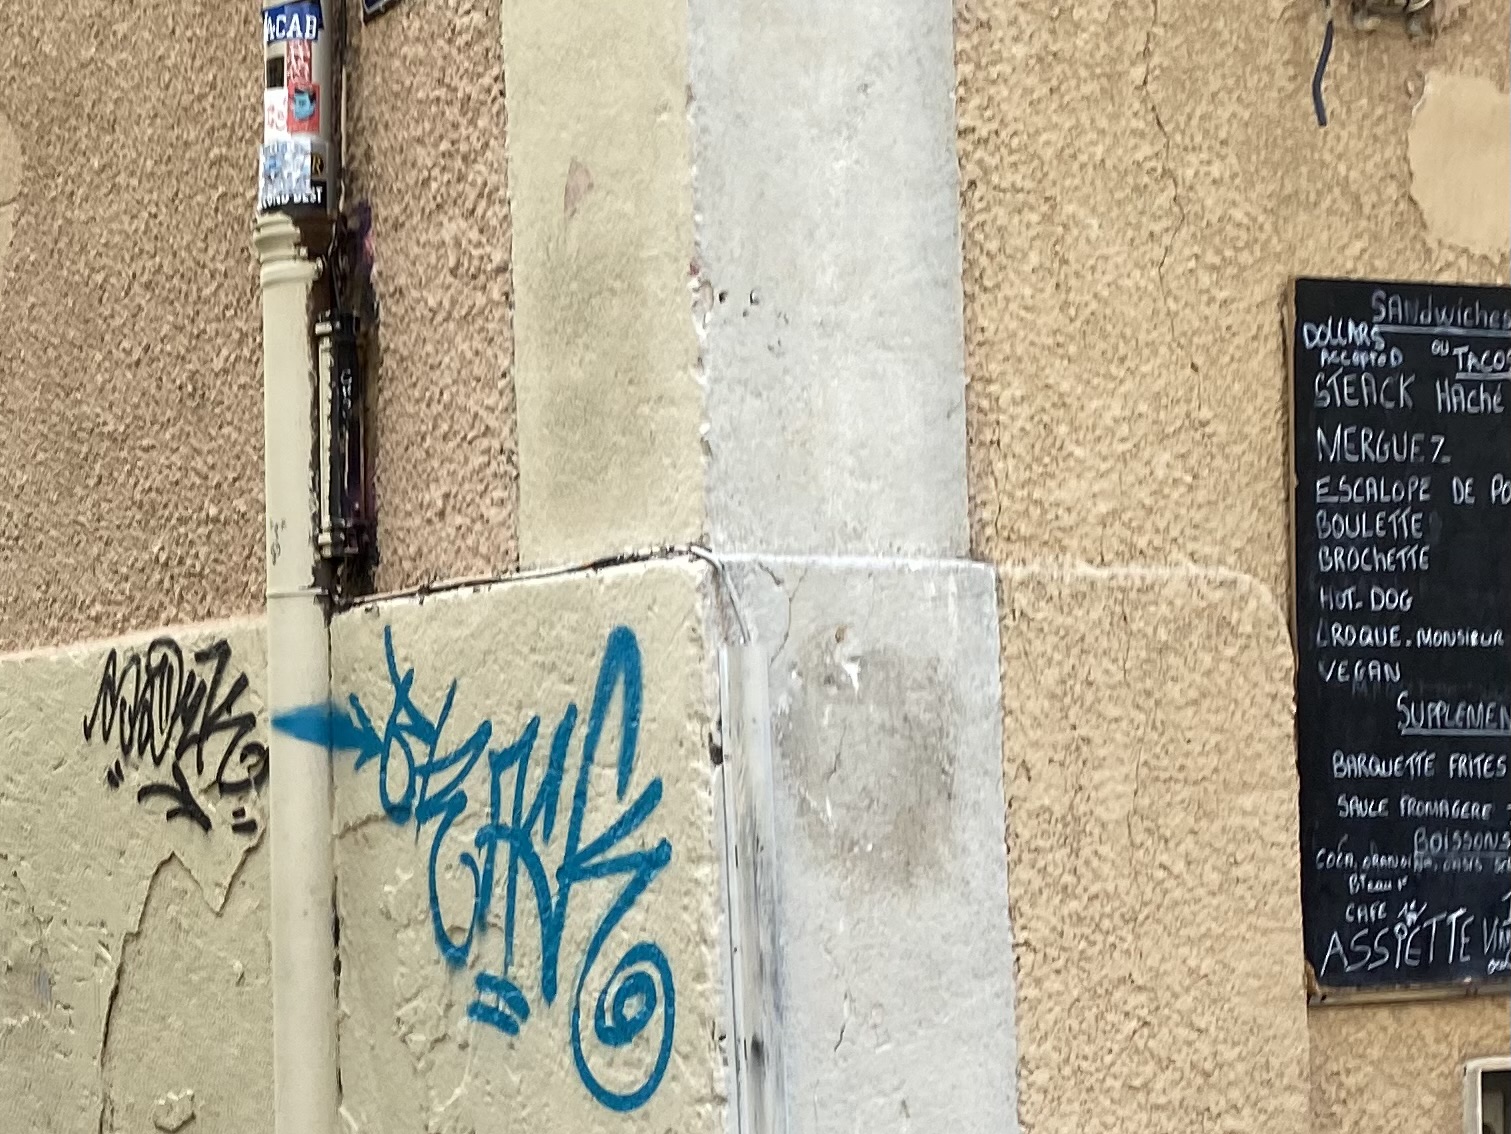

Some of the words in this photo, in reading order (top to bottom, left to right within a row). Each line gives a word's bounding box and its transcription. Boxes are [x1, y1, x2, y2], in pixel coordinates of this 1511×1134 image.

[264, 11, 318, 41] ACAB
[1303, 316, 1386, 352] DOLLARS
[1314, 366, 1416, 410] STEACK
[1316, 422, 1451, 464] MERGUEZ
[1316, 473, 1431, 503] ESCALOPE
[1452, 476, 1476, 505] DE
[1316, 506, 1424, 541] BOULETTE
[1318, 658, 1402, 683] VEGAN
[1332, 750, 1436, 780] BARQUETTE
[1449, 752, 1507, 778] FRITES
[1338, 793, 1389, 818] SAUCE
[1320, 907, 1475, 978] ASSIETTE
